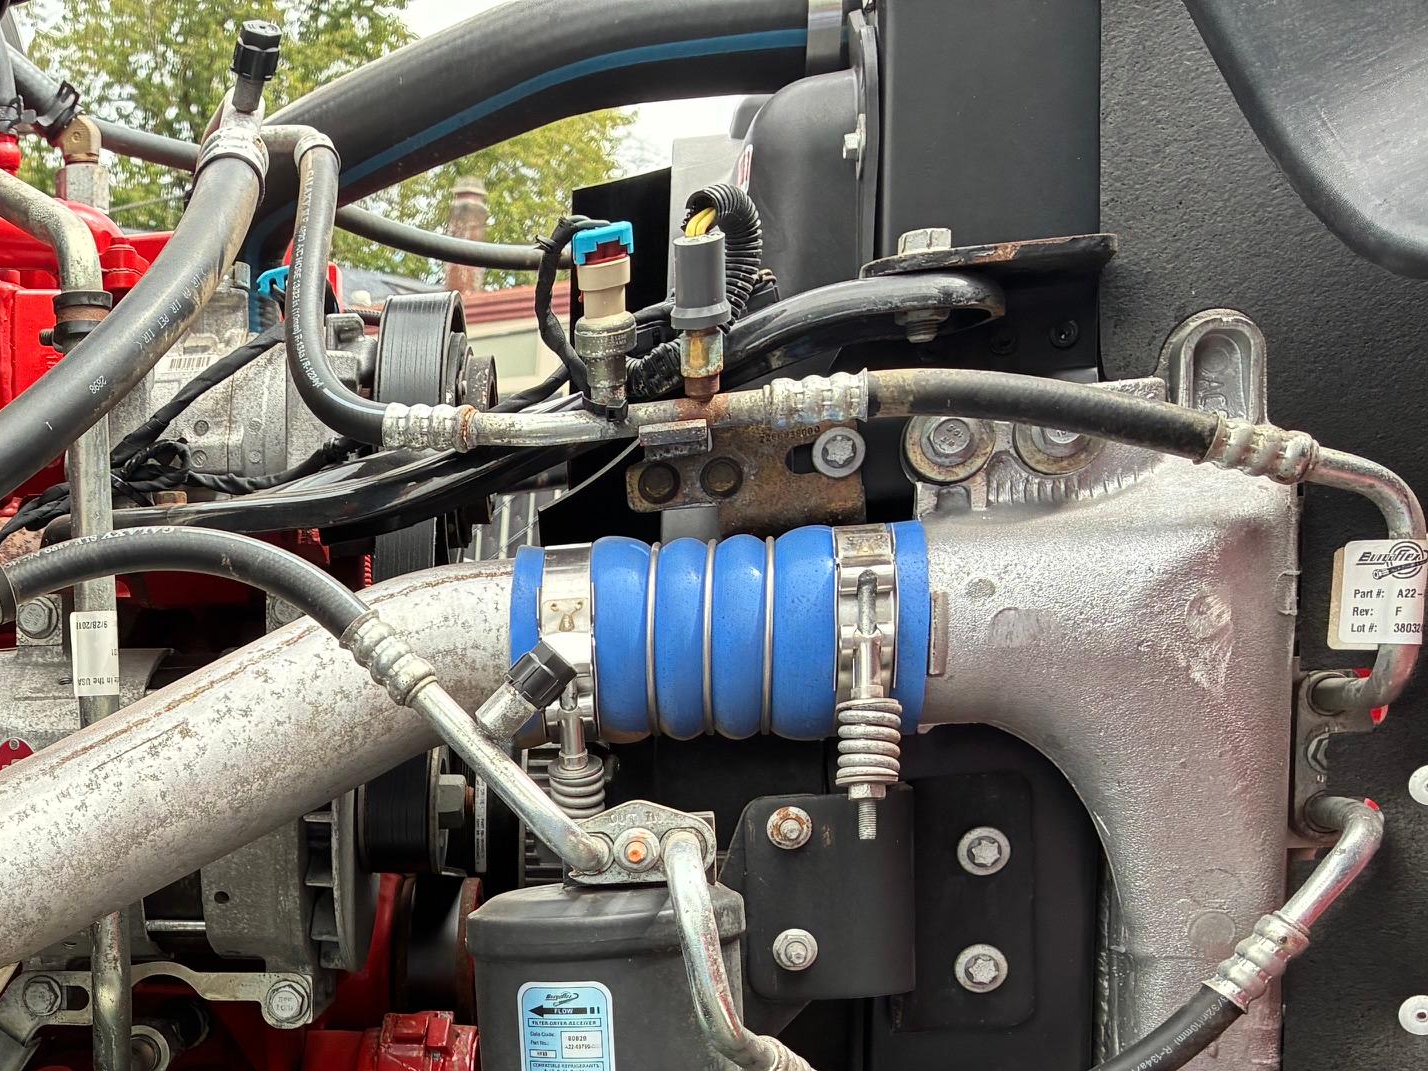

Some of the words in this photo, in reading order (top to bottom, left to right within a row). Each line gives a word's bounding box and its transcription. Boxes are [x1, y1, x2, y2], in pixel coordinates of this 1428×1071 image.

[1353, 588, 1373, 599] Part
[1375, 588, 1385, 599] #:
[1352, 606, 1374, 616] Rev:
[1395, 606, 1402, 616] F
[1351, 623, 1366, 633] Lot
[1368, 623, 1378, 633] #:
[77, 677, 91, 687] USA
[93, 677, 106, 685] the
